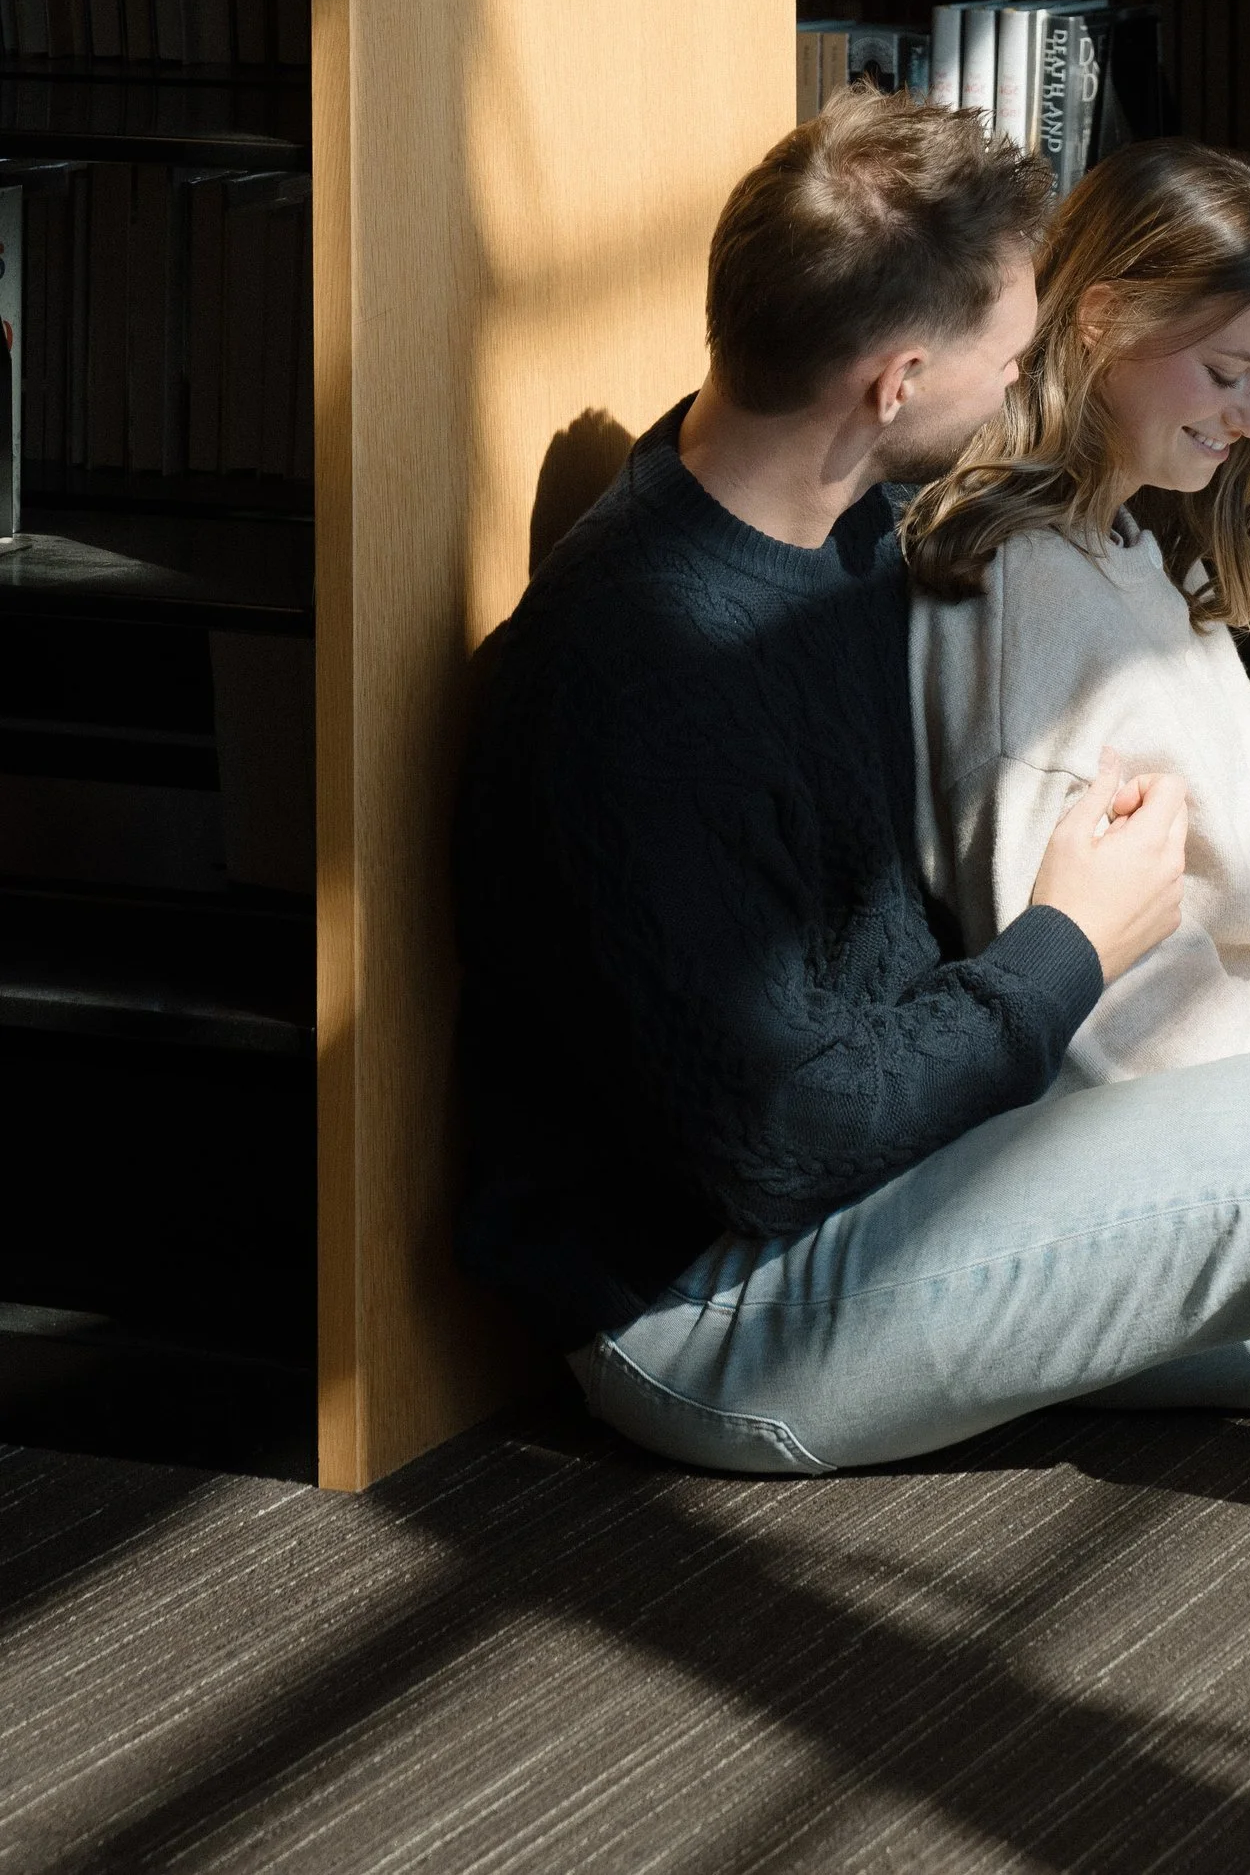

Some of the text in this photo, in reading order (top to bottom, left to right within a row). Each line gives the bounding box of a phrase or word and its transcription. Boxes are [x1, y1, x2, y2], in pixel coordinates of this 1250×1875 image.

[1039, 84, 1054, 141] DEVIL
[1047, 29, 1068, 153] DEATH AND
